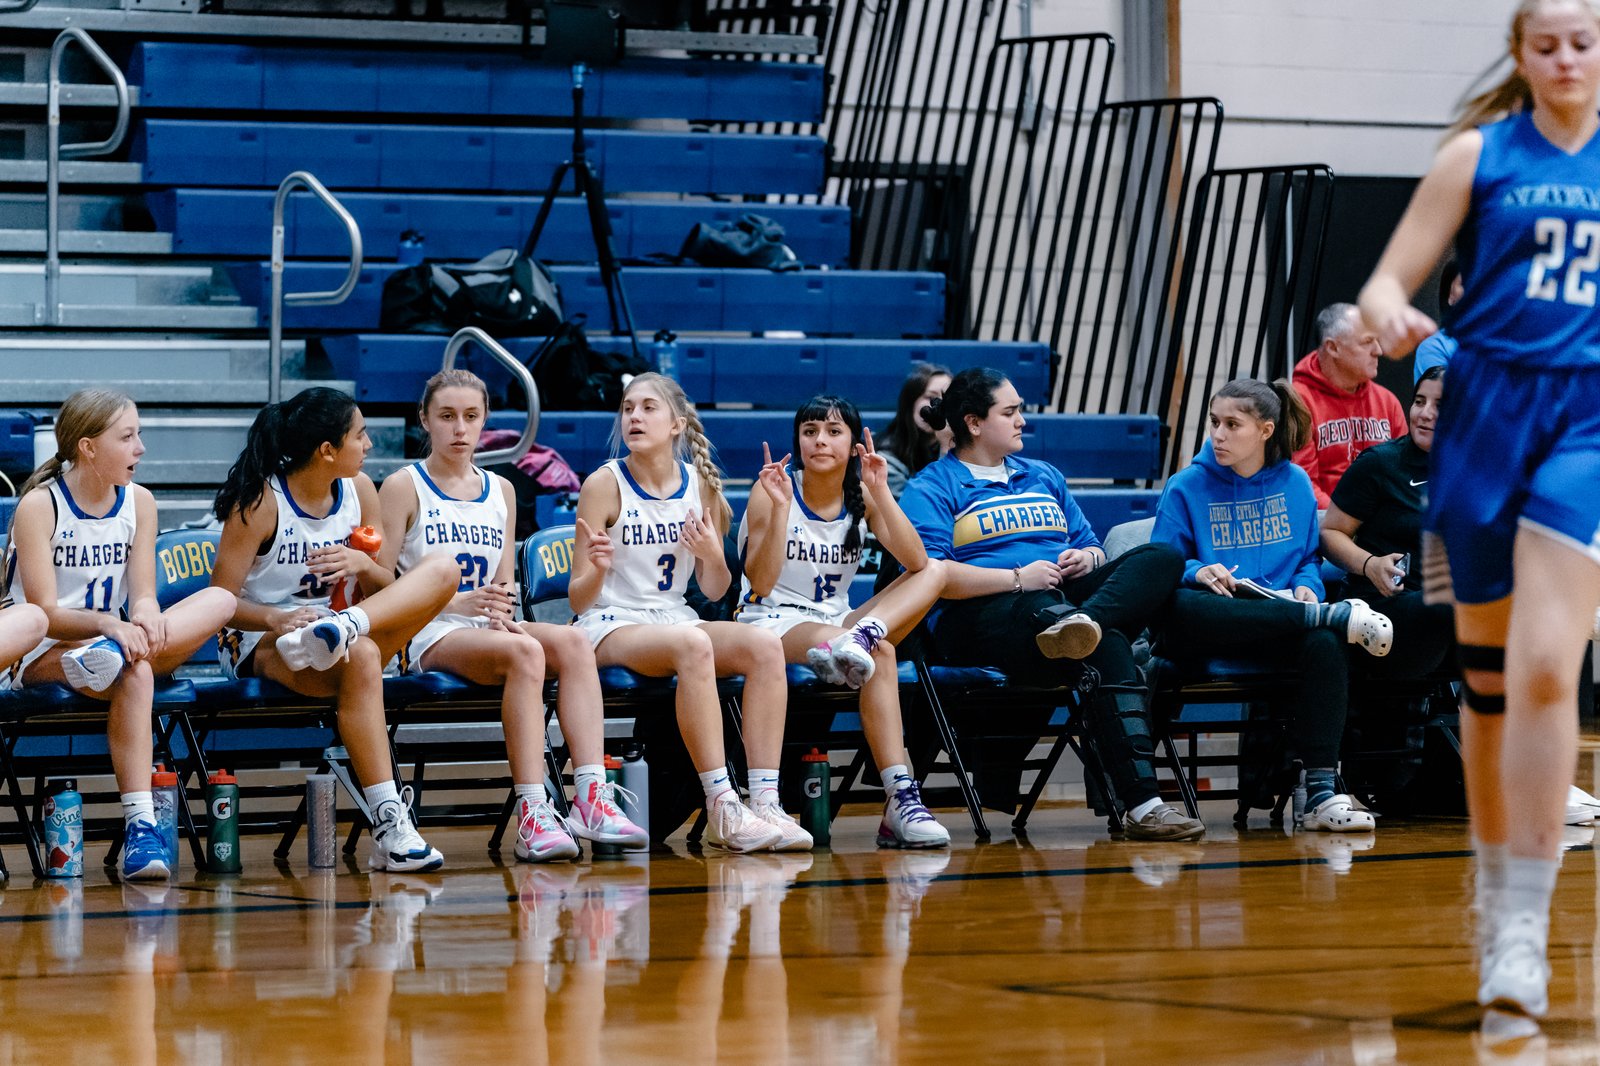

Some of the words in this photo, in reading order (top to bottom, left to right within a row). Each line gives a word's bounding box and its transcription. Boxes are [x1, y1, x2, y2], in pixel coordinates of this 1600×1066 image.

[1525, 217, 1600, 307] 22
[425, 522, 503, 549] CHARGERS
[1211, 513, 1292, 547] CHARGERS
[658, 554, 676, 591] 3
[85, 576, 113, 612] 11
[212, 797, 231, 820] G
